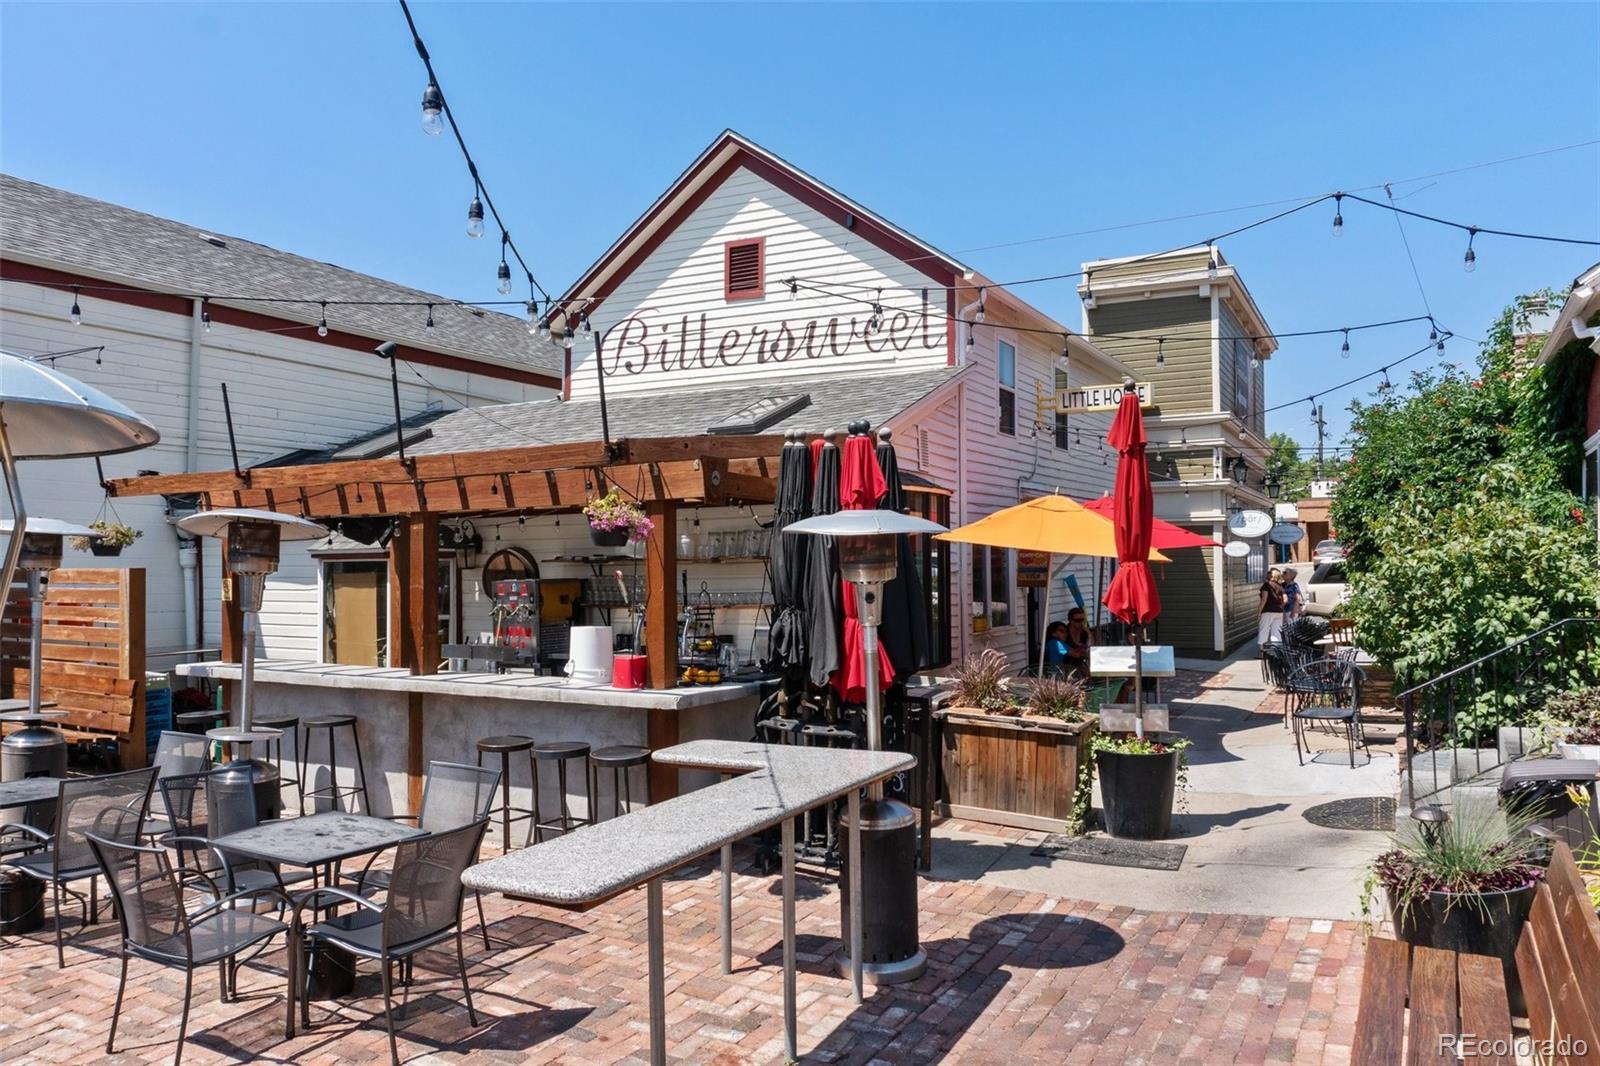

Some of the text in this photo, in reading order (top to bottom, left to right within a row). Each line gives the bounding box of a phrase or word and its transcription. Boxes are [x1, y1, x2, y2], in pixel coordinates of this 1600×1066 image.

[600, 288, 945, 376] Bittersweet
[1062, 386, 1145, 408] LITTLE HOE
